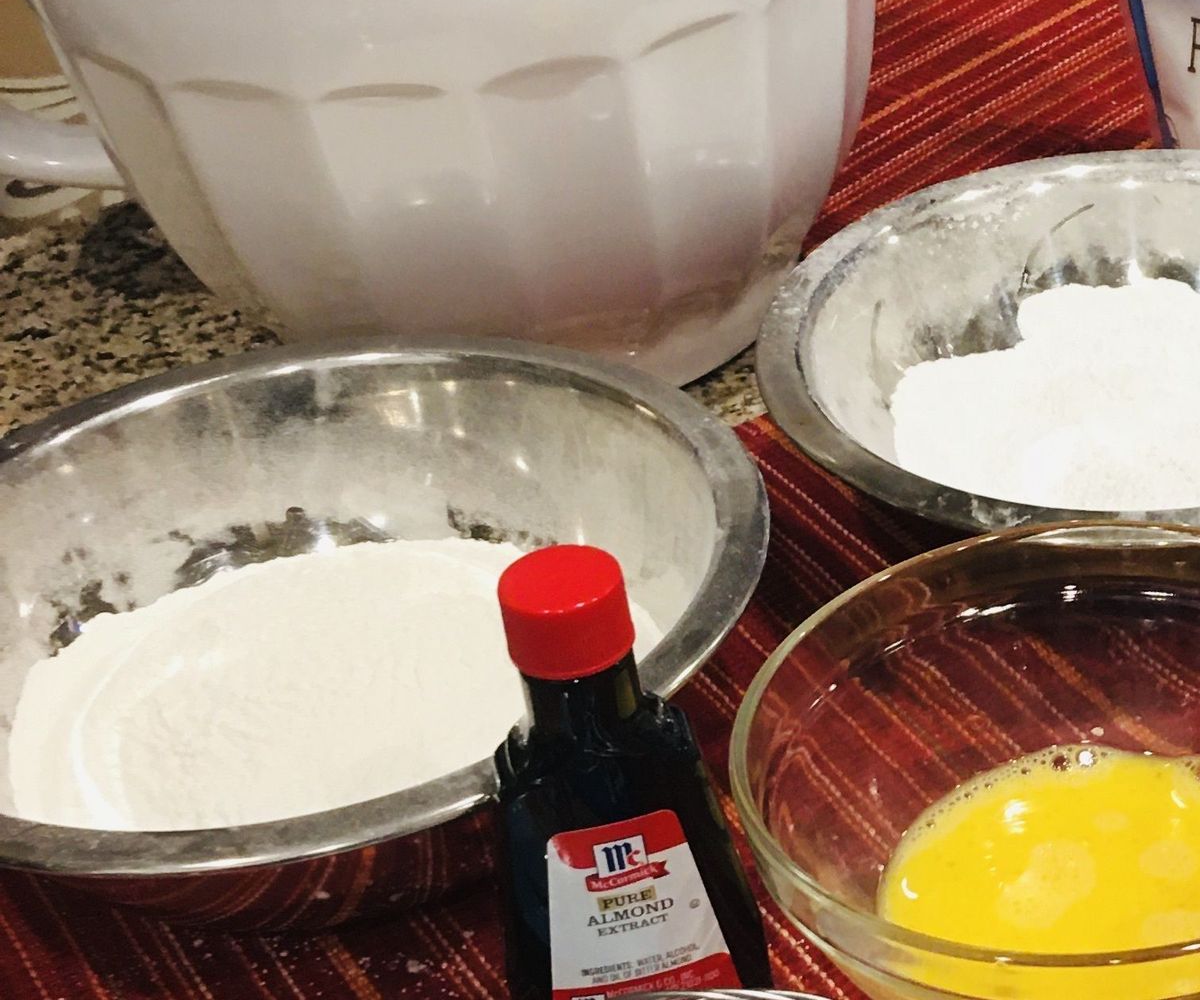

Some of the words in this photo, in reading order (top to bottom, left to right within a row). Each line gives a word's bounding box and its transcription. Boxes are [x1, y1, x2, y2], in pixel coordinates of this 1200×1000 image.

[589, 865, 658, 889] McCormick
[602, 889, 652, 910] PURE
[587, 897, 674, 927] ALMOND
[598, 913, 669, 937] EXTRACT
